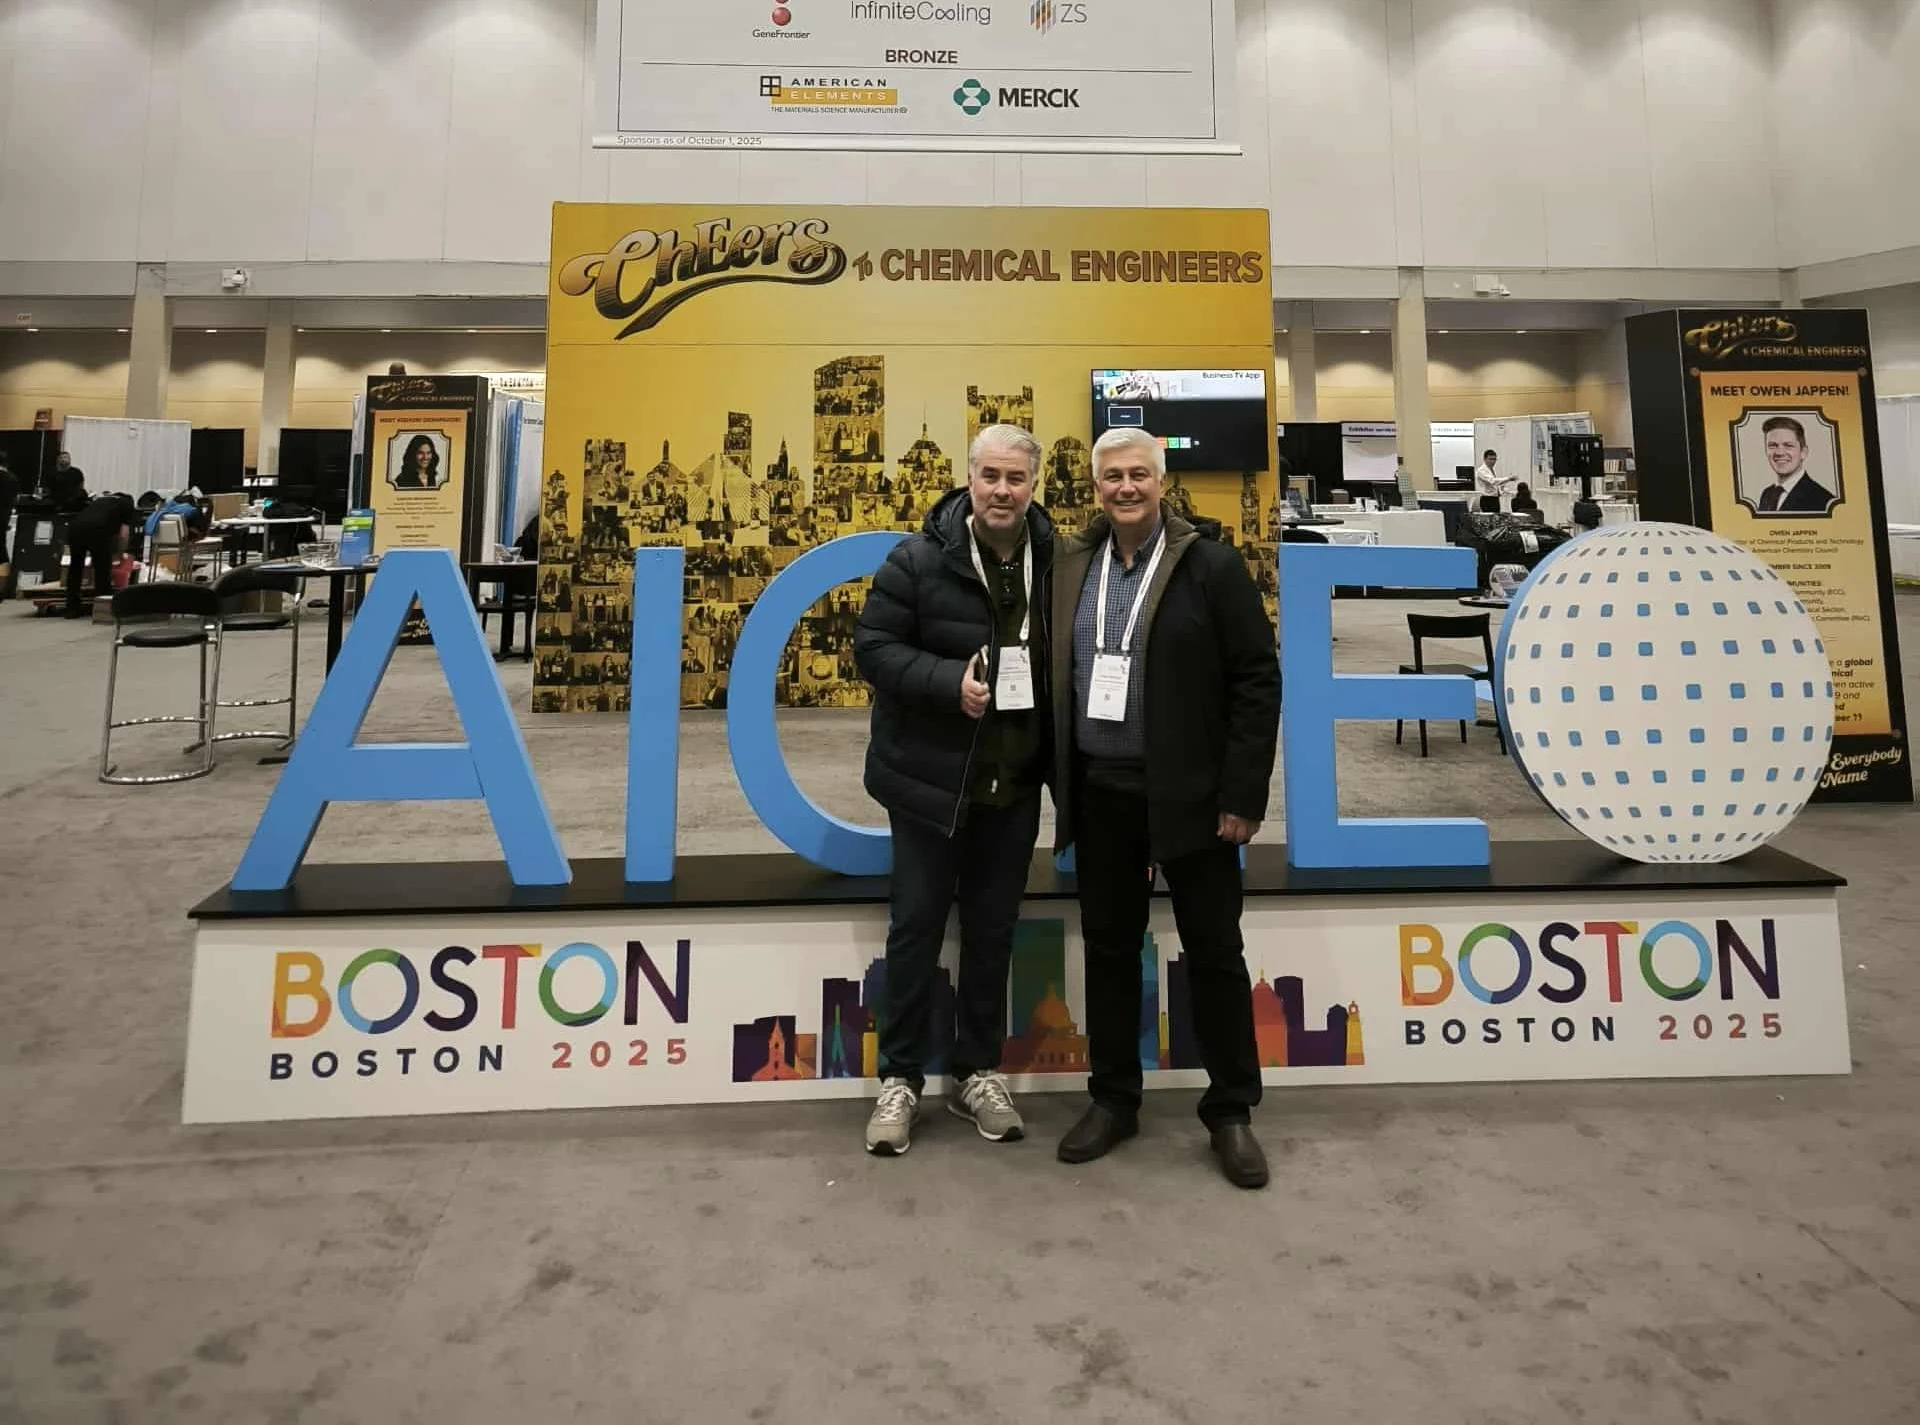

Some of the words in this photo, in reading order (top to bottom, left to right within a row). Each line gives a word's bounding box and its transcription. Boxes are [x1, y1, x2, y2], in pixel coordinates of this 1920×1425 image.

[1060, 4, 1088, 23] ZS
[752, 29, 811, 40] GeneFrontier
[885, 49, 959, 64] BRONZE
[791, 78, 887, 87] AMERICAN
[790, 90, 887, 100] ELEMENTS
[998, 88, 1080, 109] MERCK
[617, 135, 660, 146] Sponsors
[676, 136, 686, 145] of
[687, 136, 726, 145] October
[737, 137, 762, 145] 2025
[880, 248, 1061, 282] CHEMICAL
[1071, 249, 1264, 283] ENGINEERS
[1751, 345, 1806, 357] CHEMICAL
[1807, 345, 1867, 357] ENGINEERS
[1202, 371, 1233, 379] Business
[1245, 371, 1261, 381] App
[1710, 385, 1746, 397] MEET
[1750, 385, 1792, 397] OWEN
[1795, 385, 1850, 397] JAPPEN!
[1829, 538, 1865, 546] Technology
[1844, 657, 1873, 668] global
[1849, 680, 1875, 689] active
[1843, 691, 1860, 699] and
[1831, 746, 1902, 771] Everybody
[1820, 770, 1868, 788] Name
[1399, 918, 1781, 1007] BOSTON
[270, 939, 691, 1039] BOSTON
[1404, 1016, 1615, 1045] BOSTON
[1658, 1013, 1782, 1040] 2025
[269, 1044, 503, 1081] BOSTON
[551, 1038, 687, 1069] 2025
